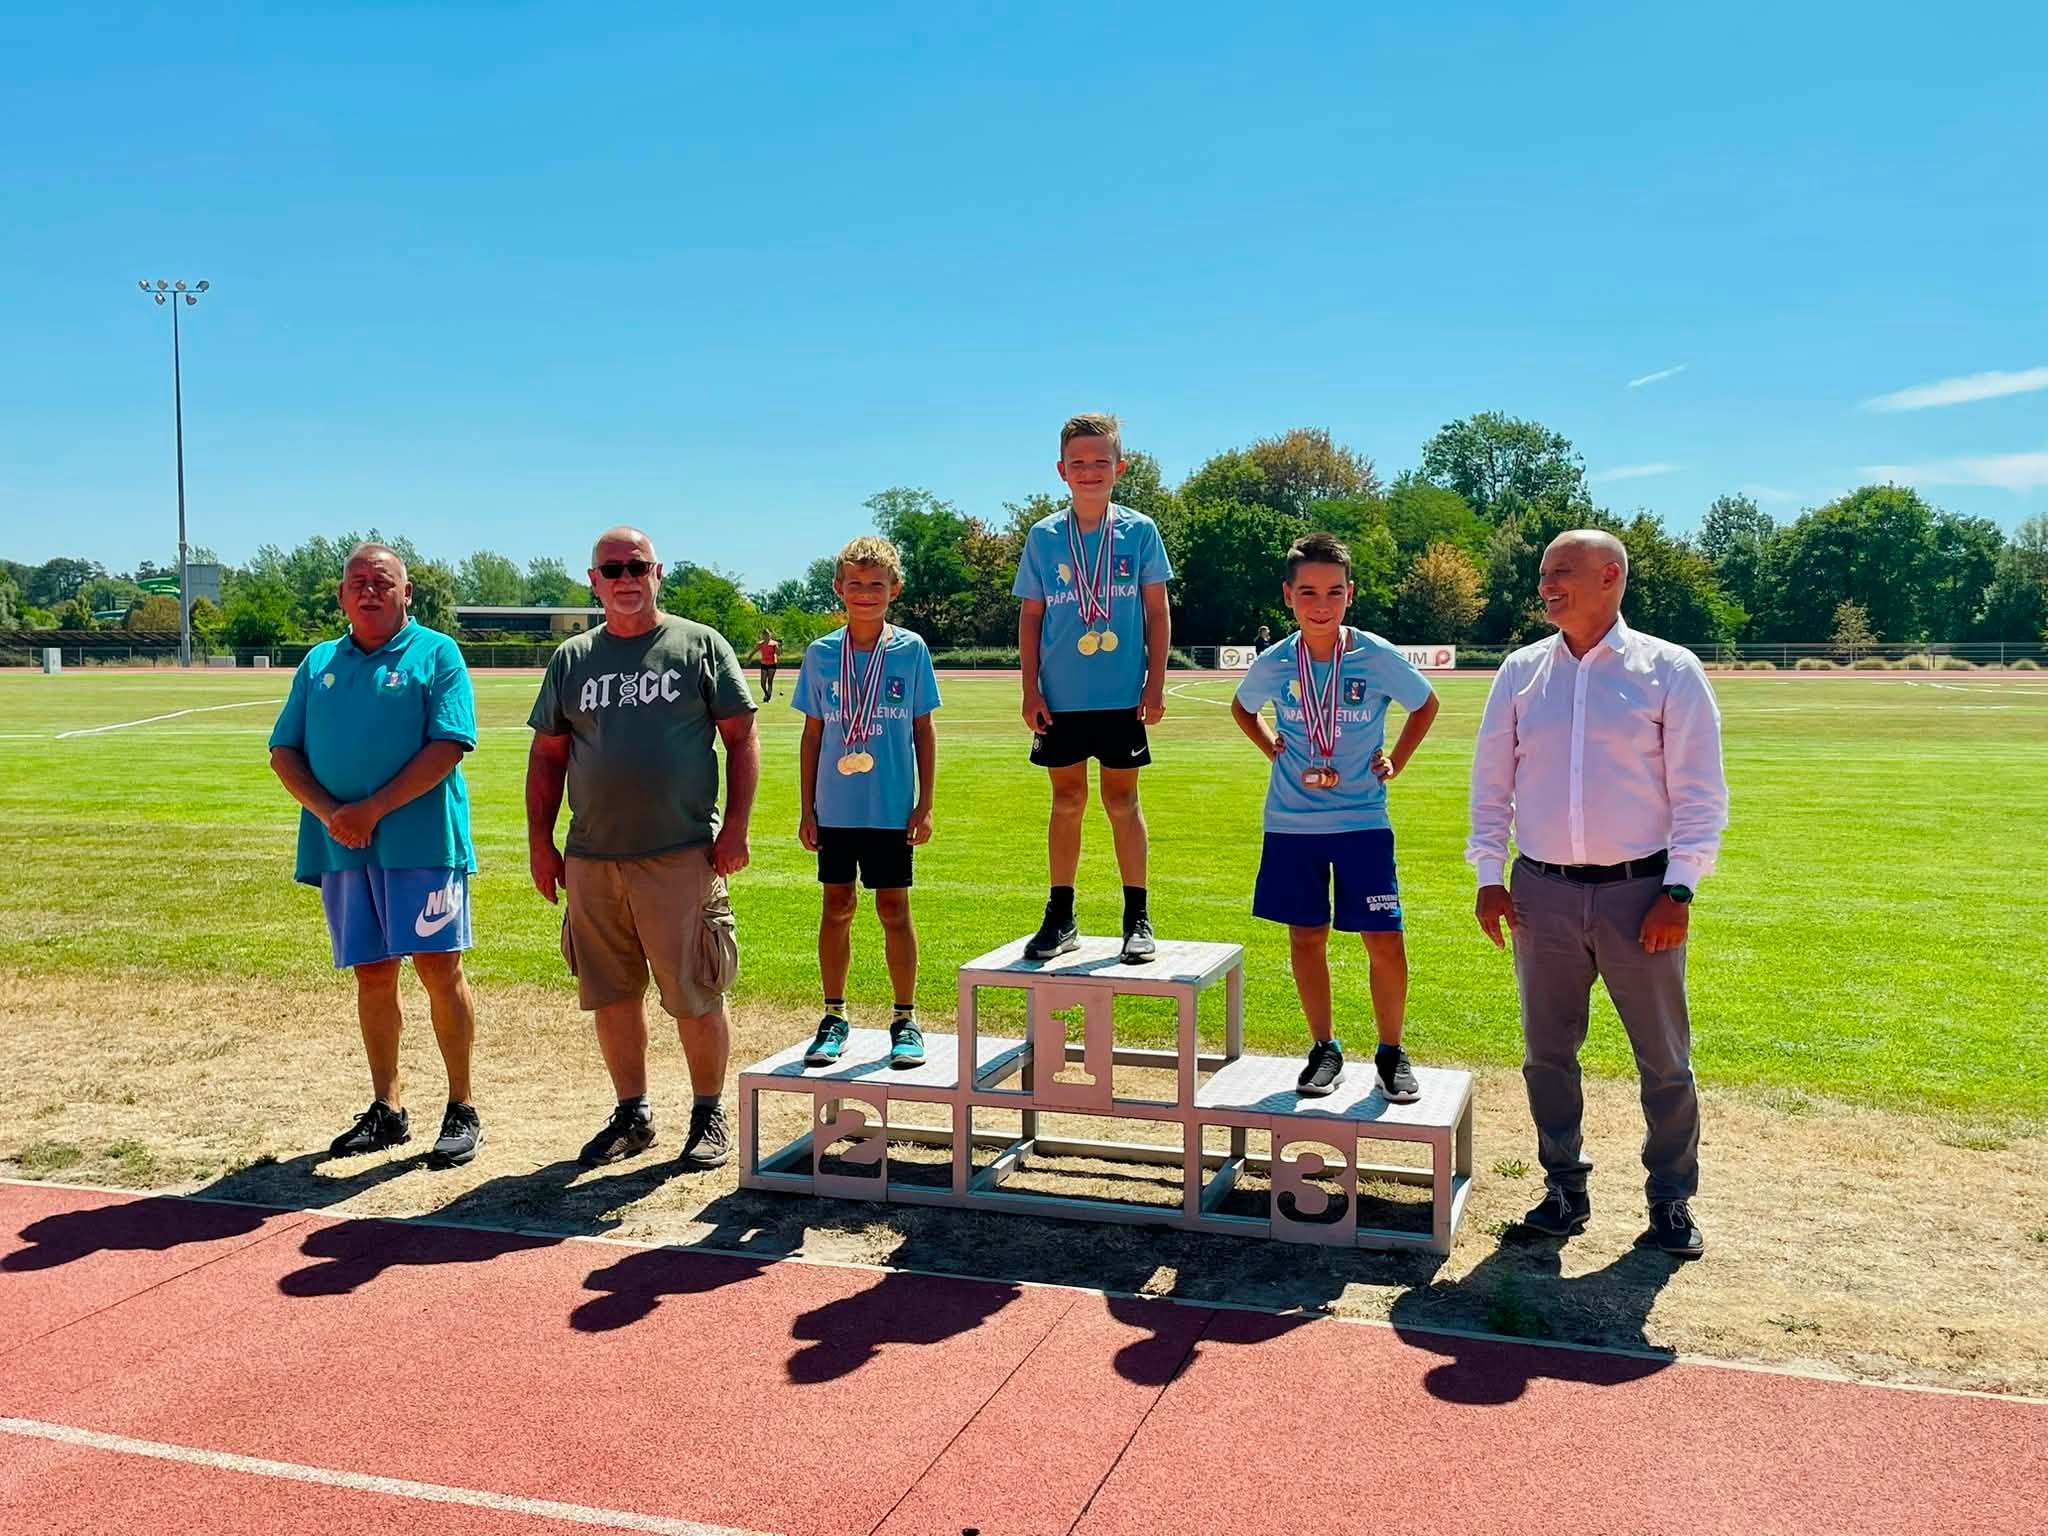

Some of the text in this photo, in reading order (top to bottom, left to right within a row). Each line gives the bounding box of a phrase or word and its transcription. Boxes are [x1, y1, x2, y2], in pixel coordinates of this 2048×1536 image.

[579, 668, 682, 713] AT GC
[1050, 1003, 1096, 1085] 1
[818, 1098, 883, 1178] 2
[1277, 1140, 1349, 1225] 3
